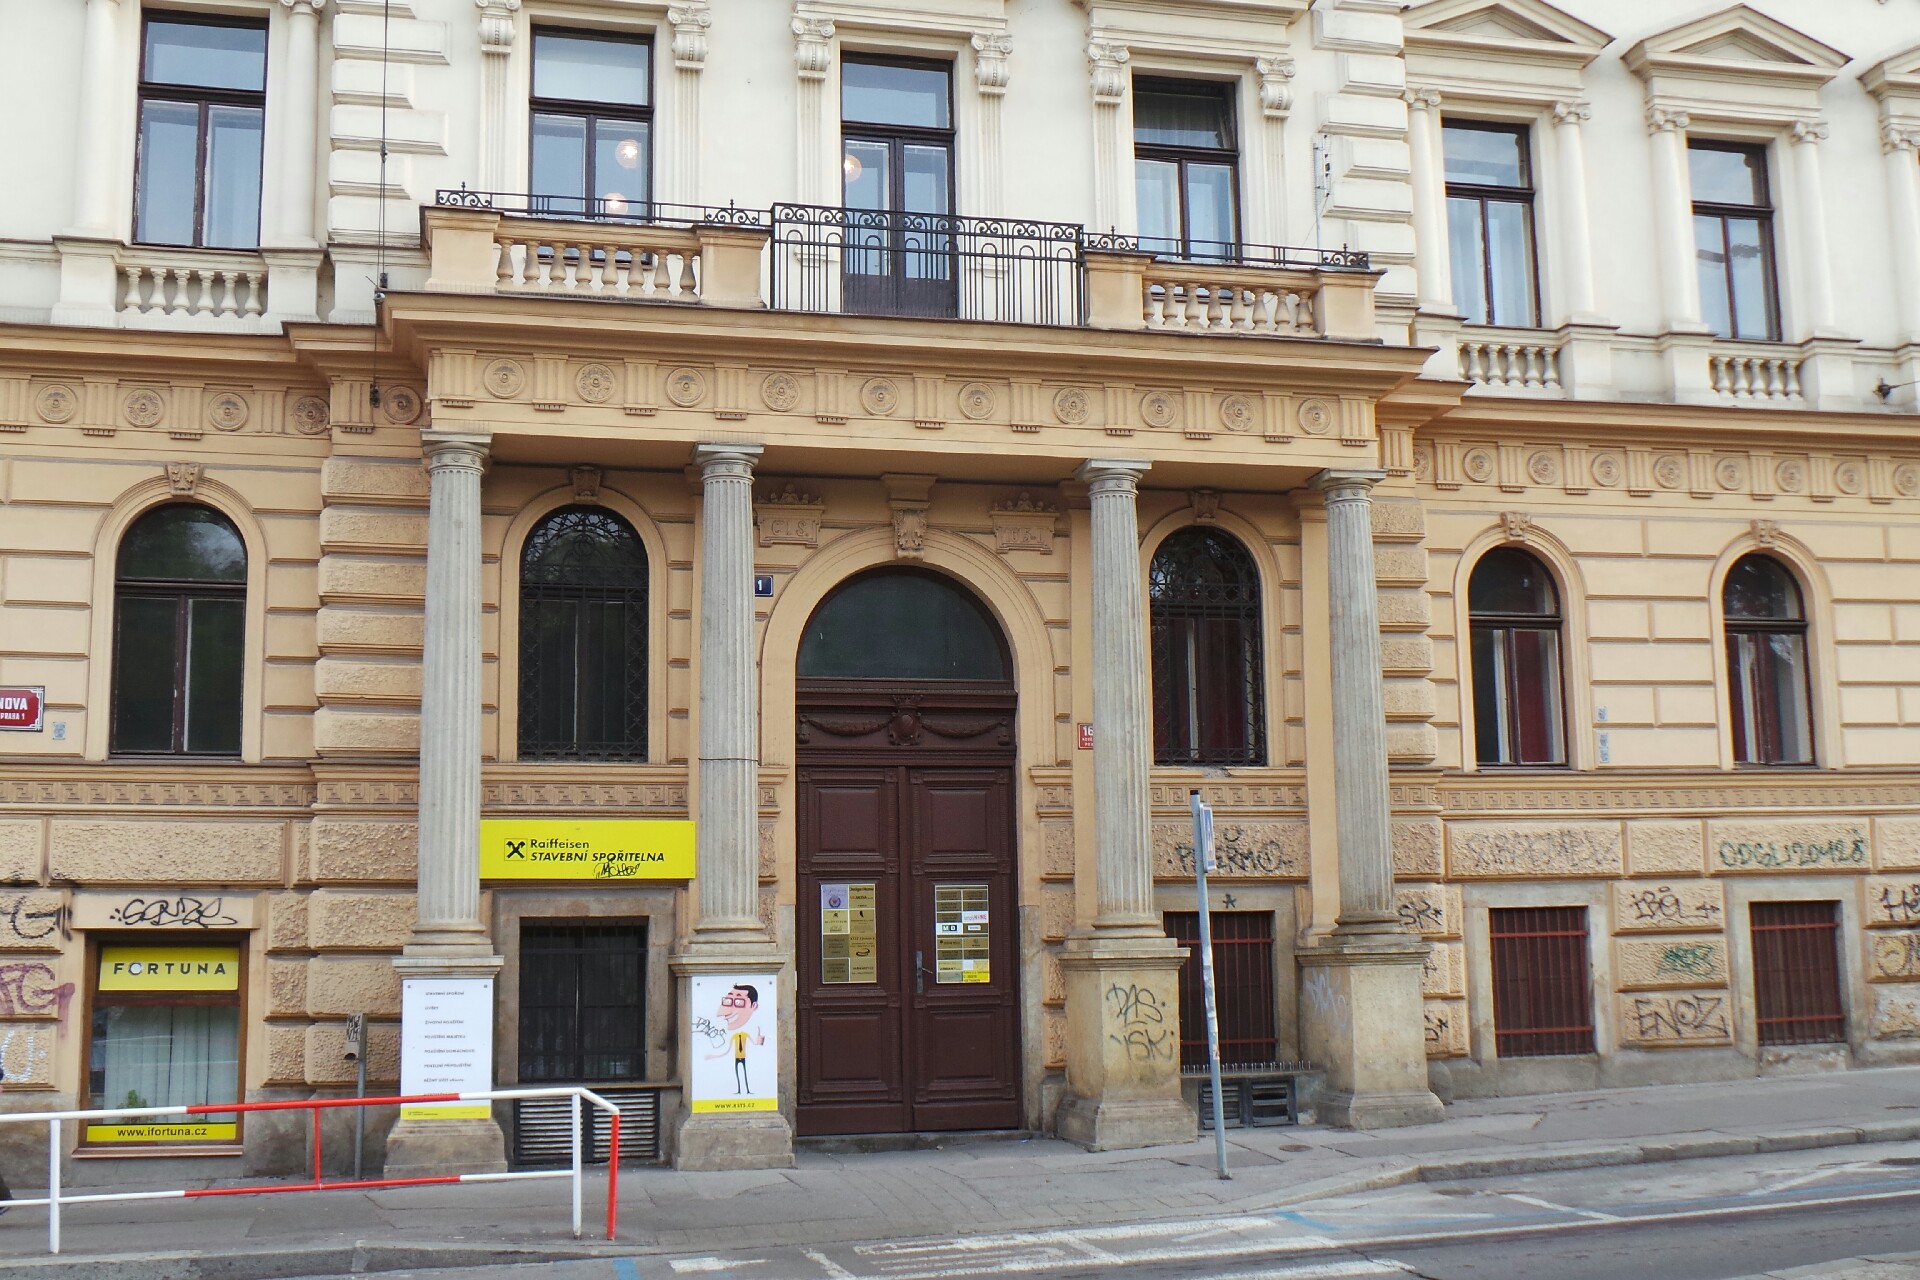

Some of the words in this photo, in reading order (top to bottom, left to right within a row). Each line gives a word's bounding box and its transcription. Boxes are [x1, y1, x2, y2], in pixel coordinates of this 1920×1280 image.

[21, 712, 25, 720] 1
[530, 838, 590, 849] Raiffeisen
[530, 849, 588, 862] STAVEBNÍ
[591, 849, 665, 862] SPOŘITELNA
[113, 962, 226, 976] FORTUNA
[117, 1126, 208, 1137] www.ifortuna.cz
